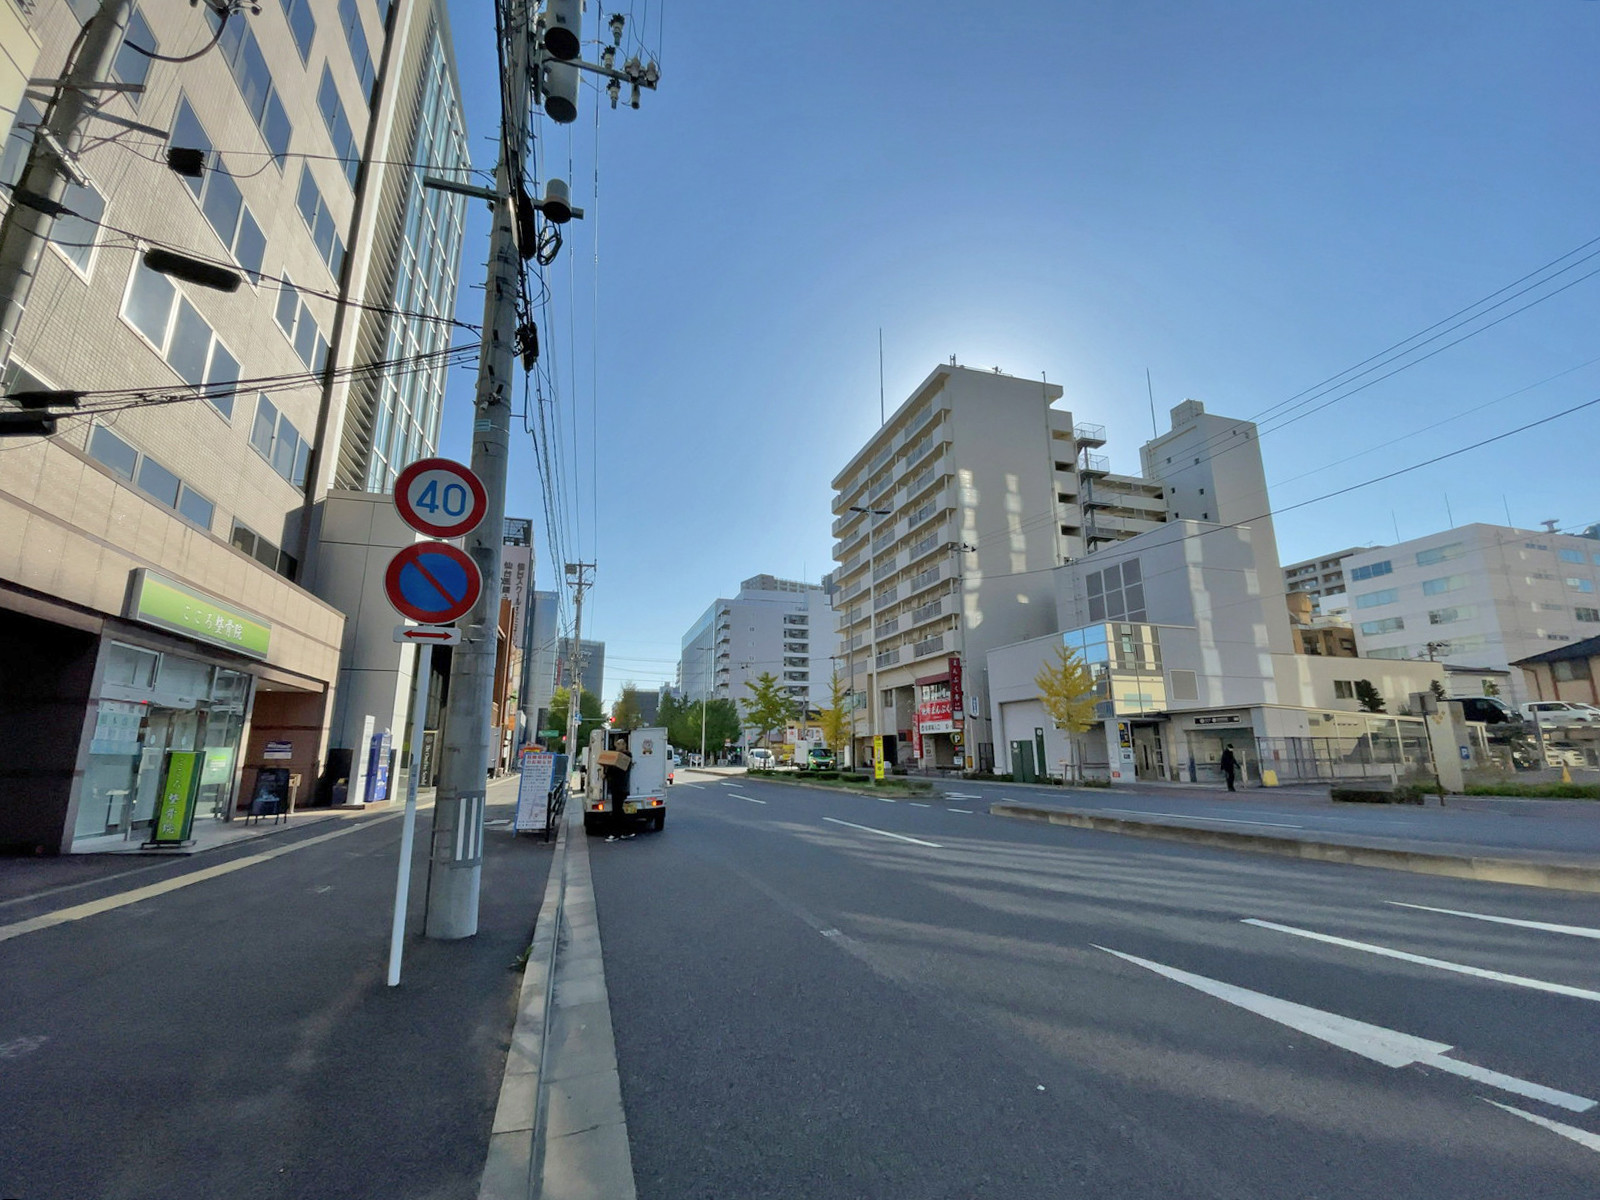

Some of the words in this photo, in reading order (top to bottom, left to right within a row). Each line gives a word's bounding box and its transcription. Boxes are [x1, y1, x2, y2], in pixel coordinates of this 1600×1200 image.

[415, 479, 467, 518] 40
[183, 604, 244, 641] こころ整骨院
[162, 757, 185, 834] こころ整骨院
